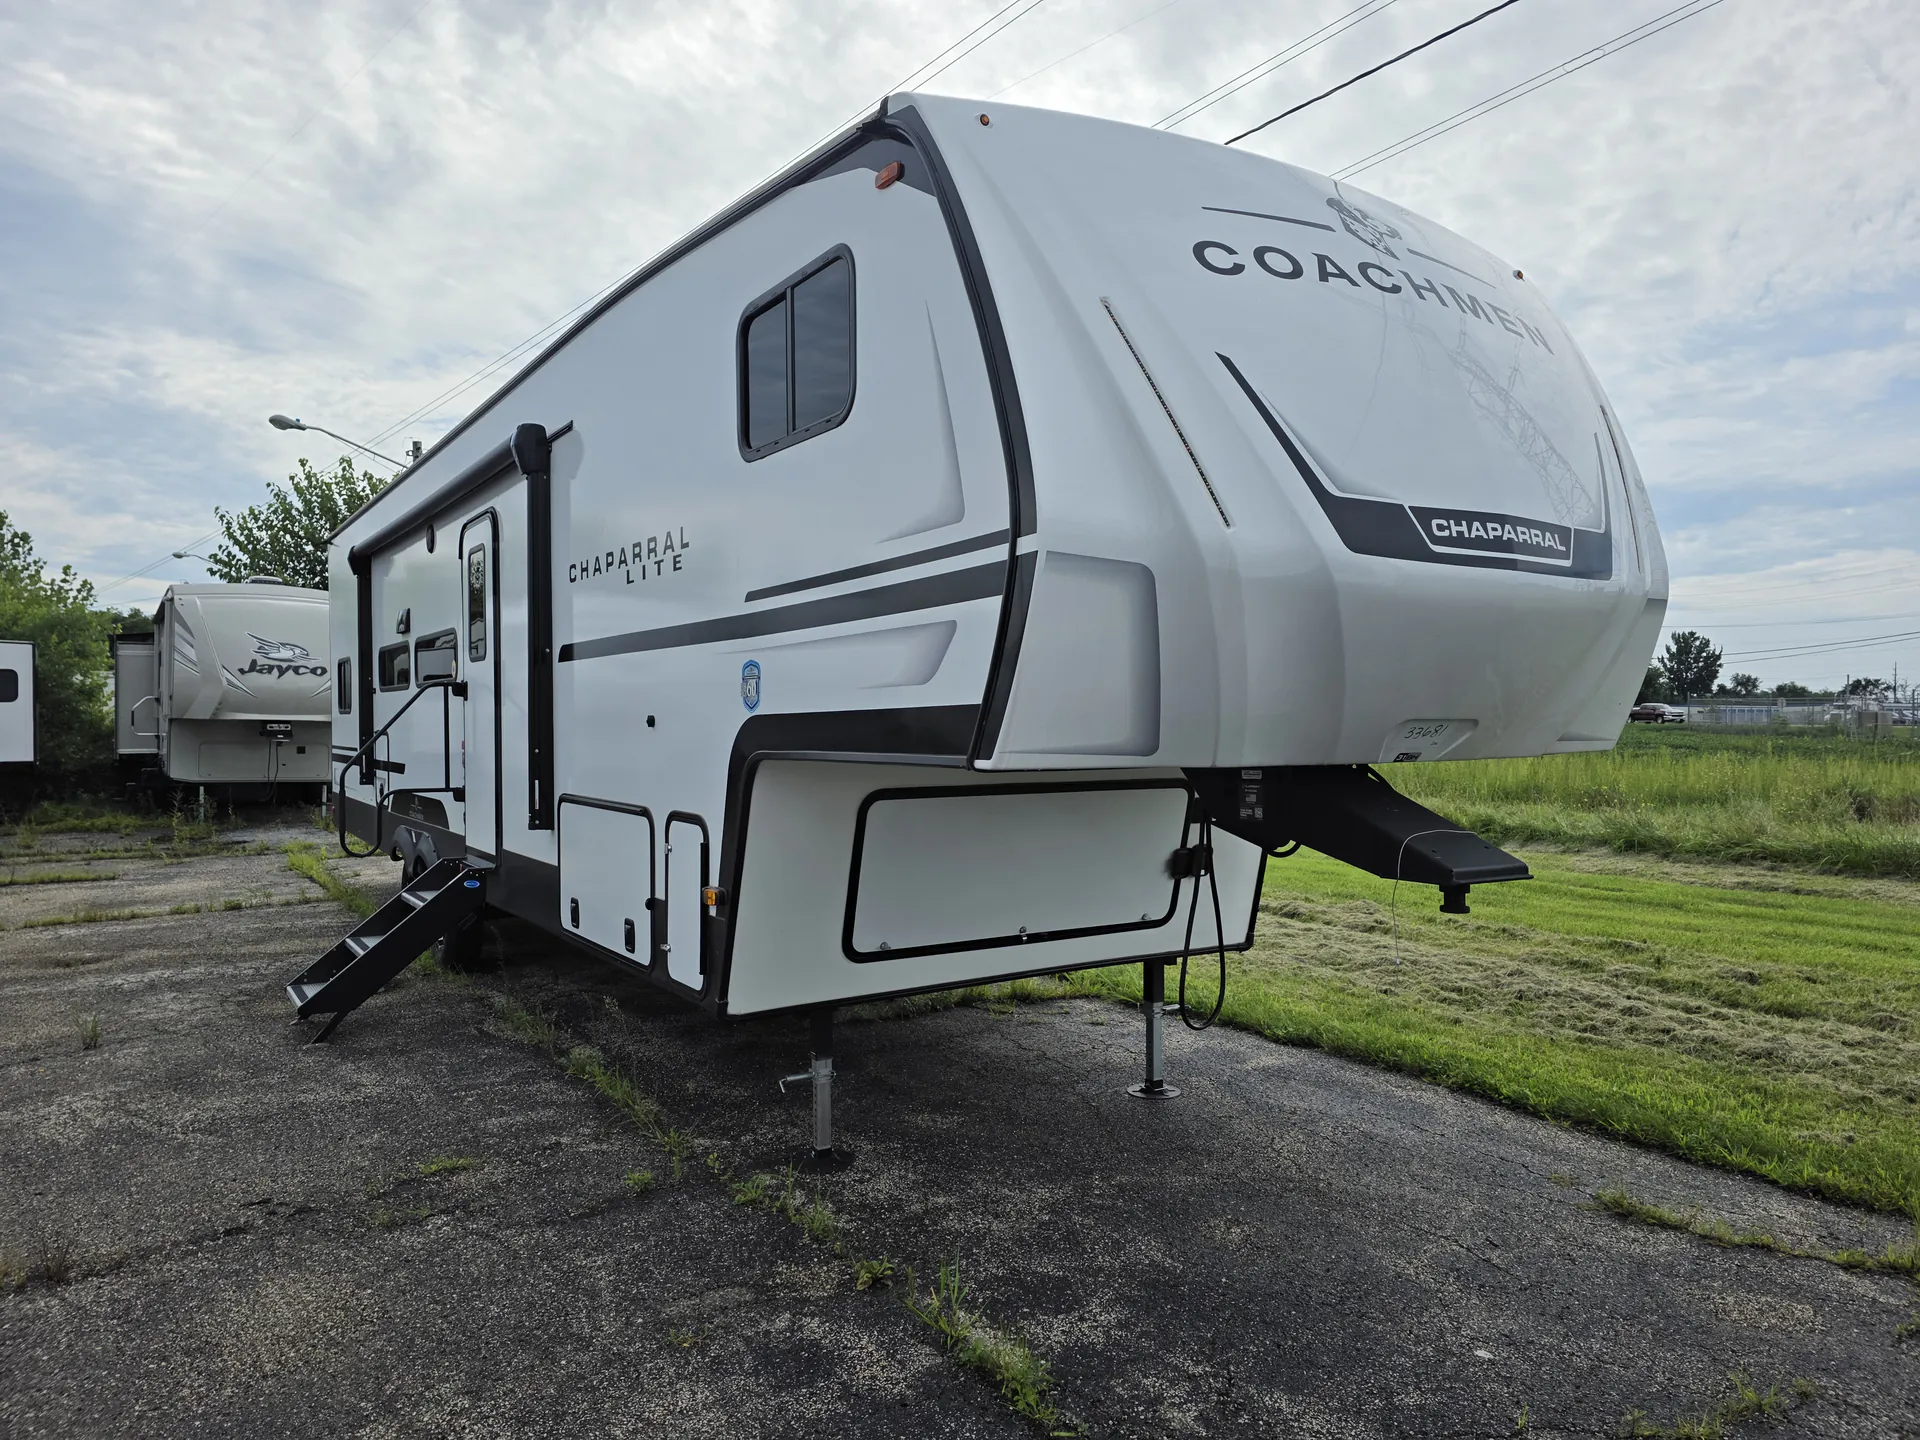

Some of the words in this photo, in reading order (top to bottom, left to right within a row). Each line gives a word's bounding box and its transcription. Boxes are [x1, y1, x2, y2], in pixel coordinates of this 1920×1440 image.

[1192, 240, 1554, 355] COACHMEN
[1431, 519, 1566, 551] CHAPARRAL
[569, 526, 690, 583] CHAPARRAL
[626, 554, 682, 584] LITE
[238, 659, 328, 679] Jayco
[1404, 724, 1450, 739] 33681
